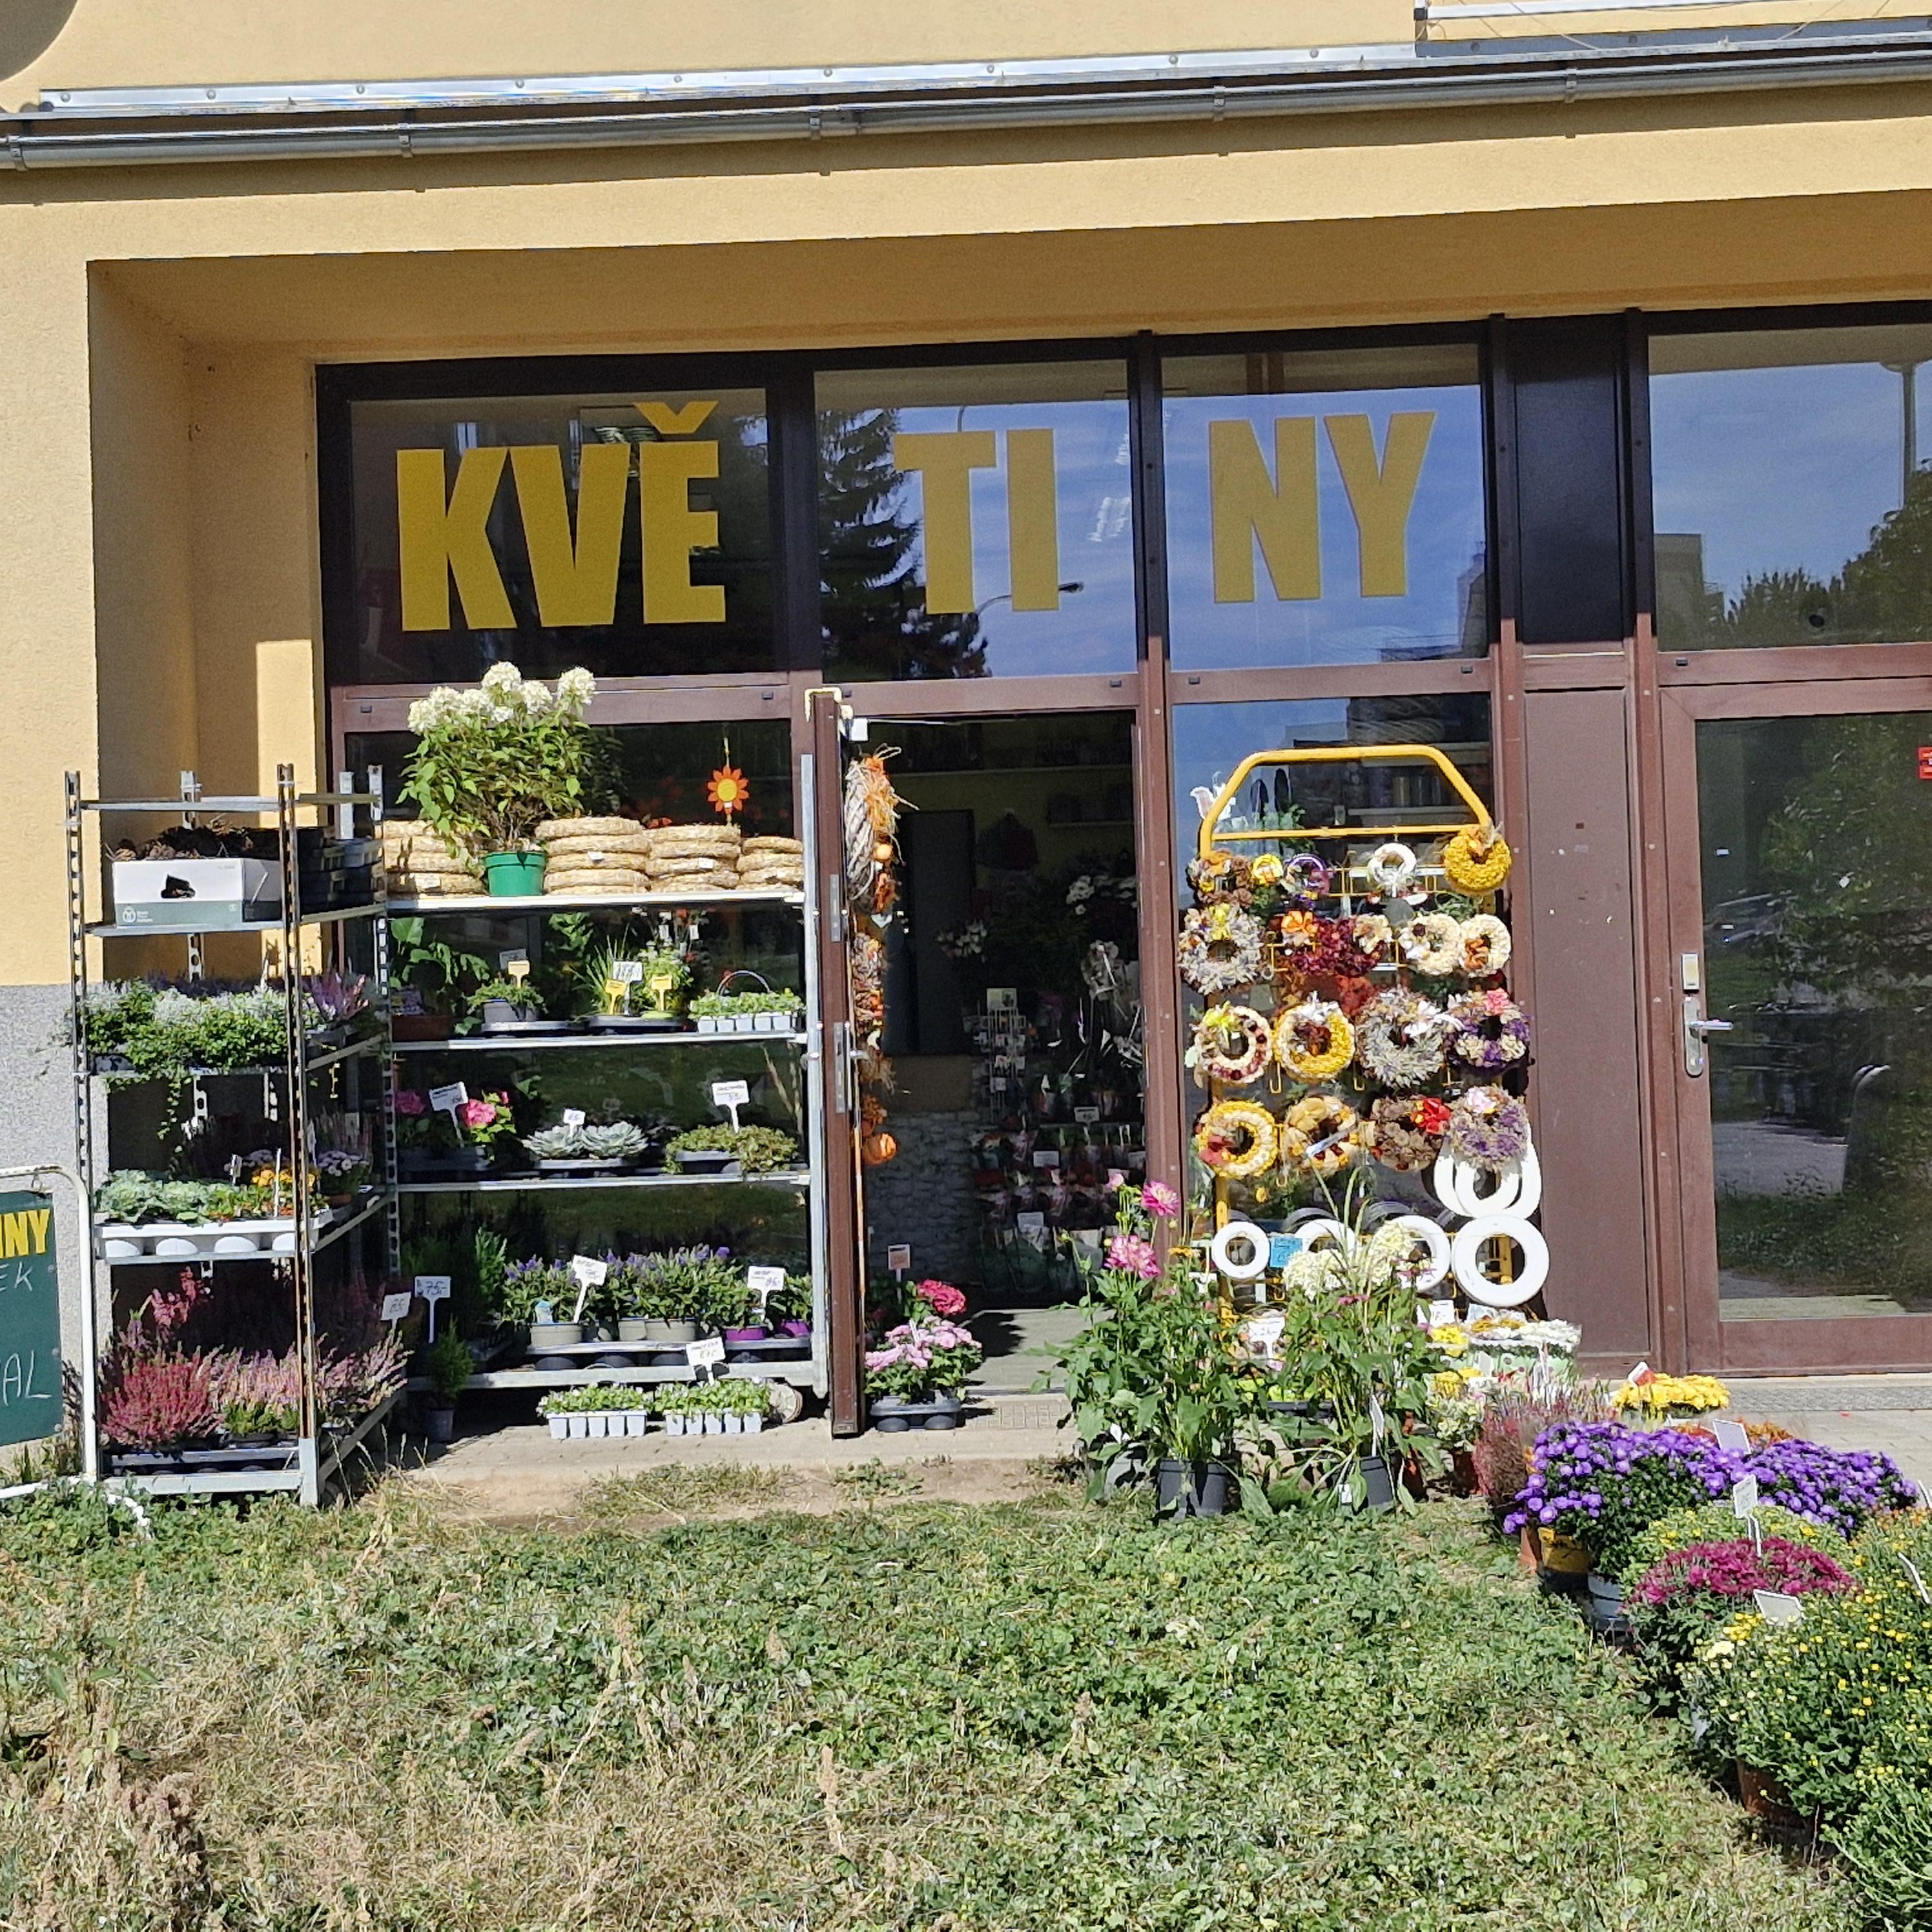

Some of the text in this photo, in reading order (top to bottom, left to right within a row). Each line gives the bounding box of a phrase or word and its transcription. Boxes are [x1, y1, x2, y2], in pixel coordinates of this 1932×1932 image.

[396, 400, 1436, 632] KVĚ TI NY
